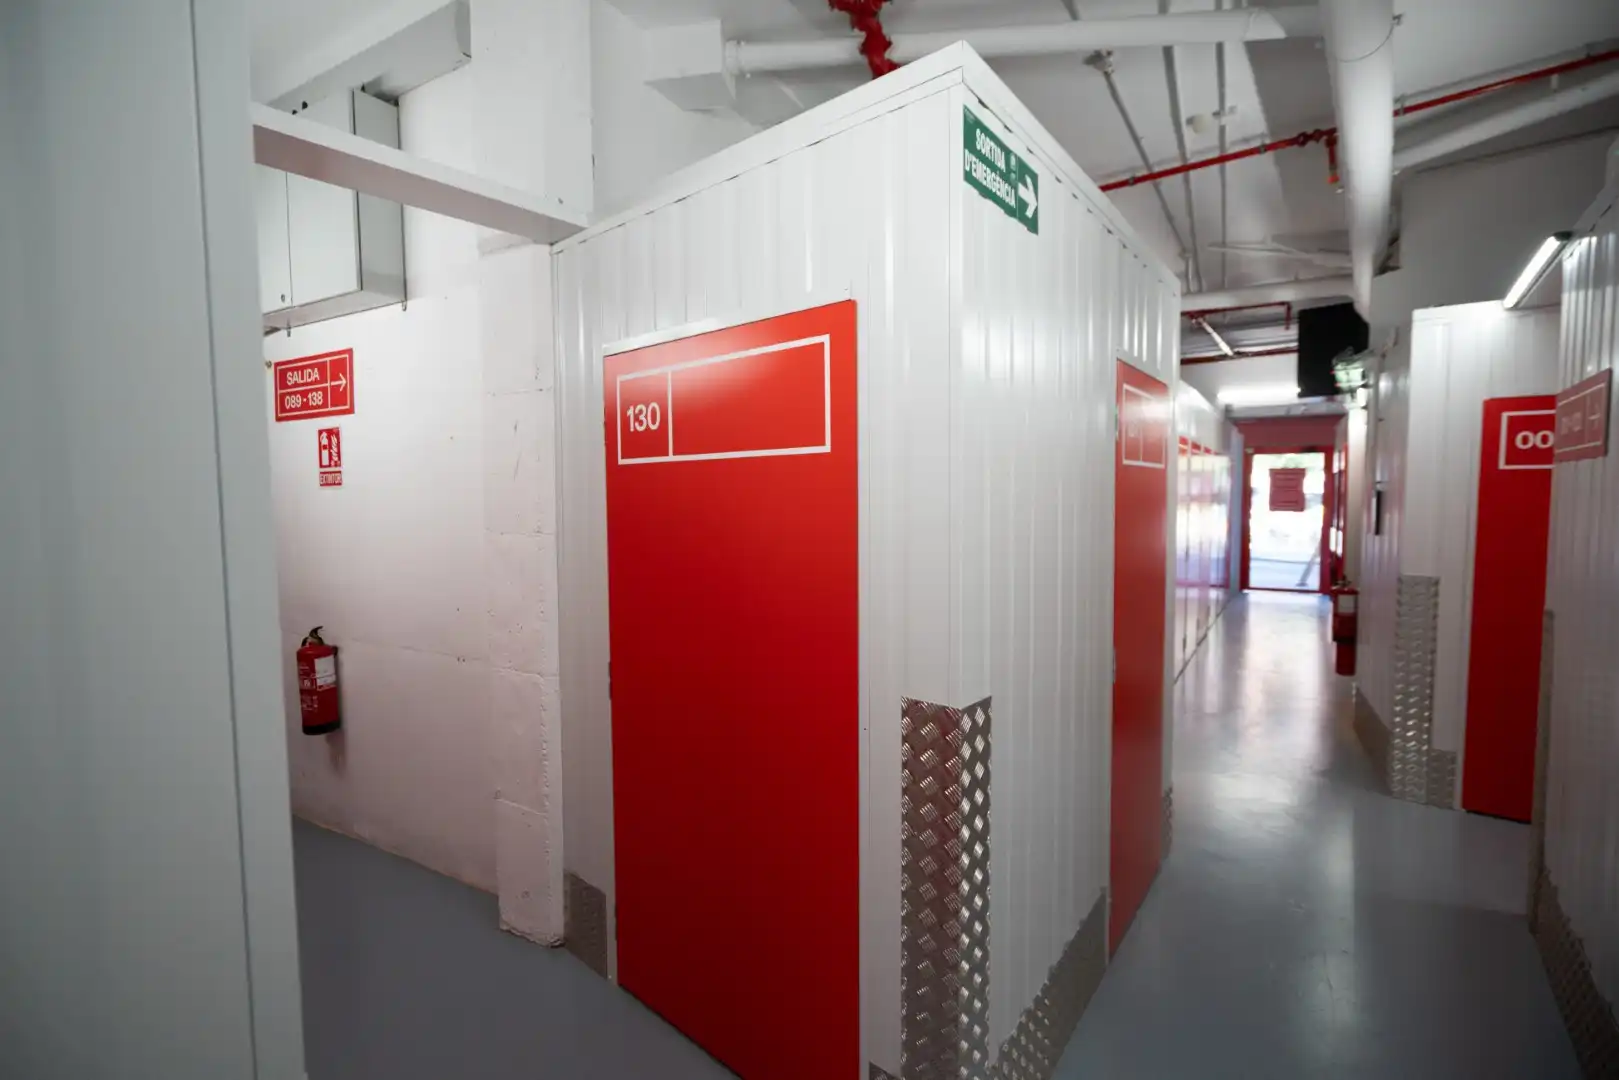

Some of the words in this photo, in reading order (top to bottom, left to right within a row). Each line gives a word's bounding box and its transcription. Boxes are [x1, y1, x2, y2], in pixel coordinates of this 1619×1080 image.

[976, 128, 1006, 173] SORTIDA
[286, 367, 320, 386] SALIDA
[626, 402, 661, 432] 130
